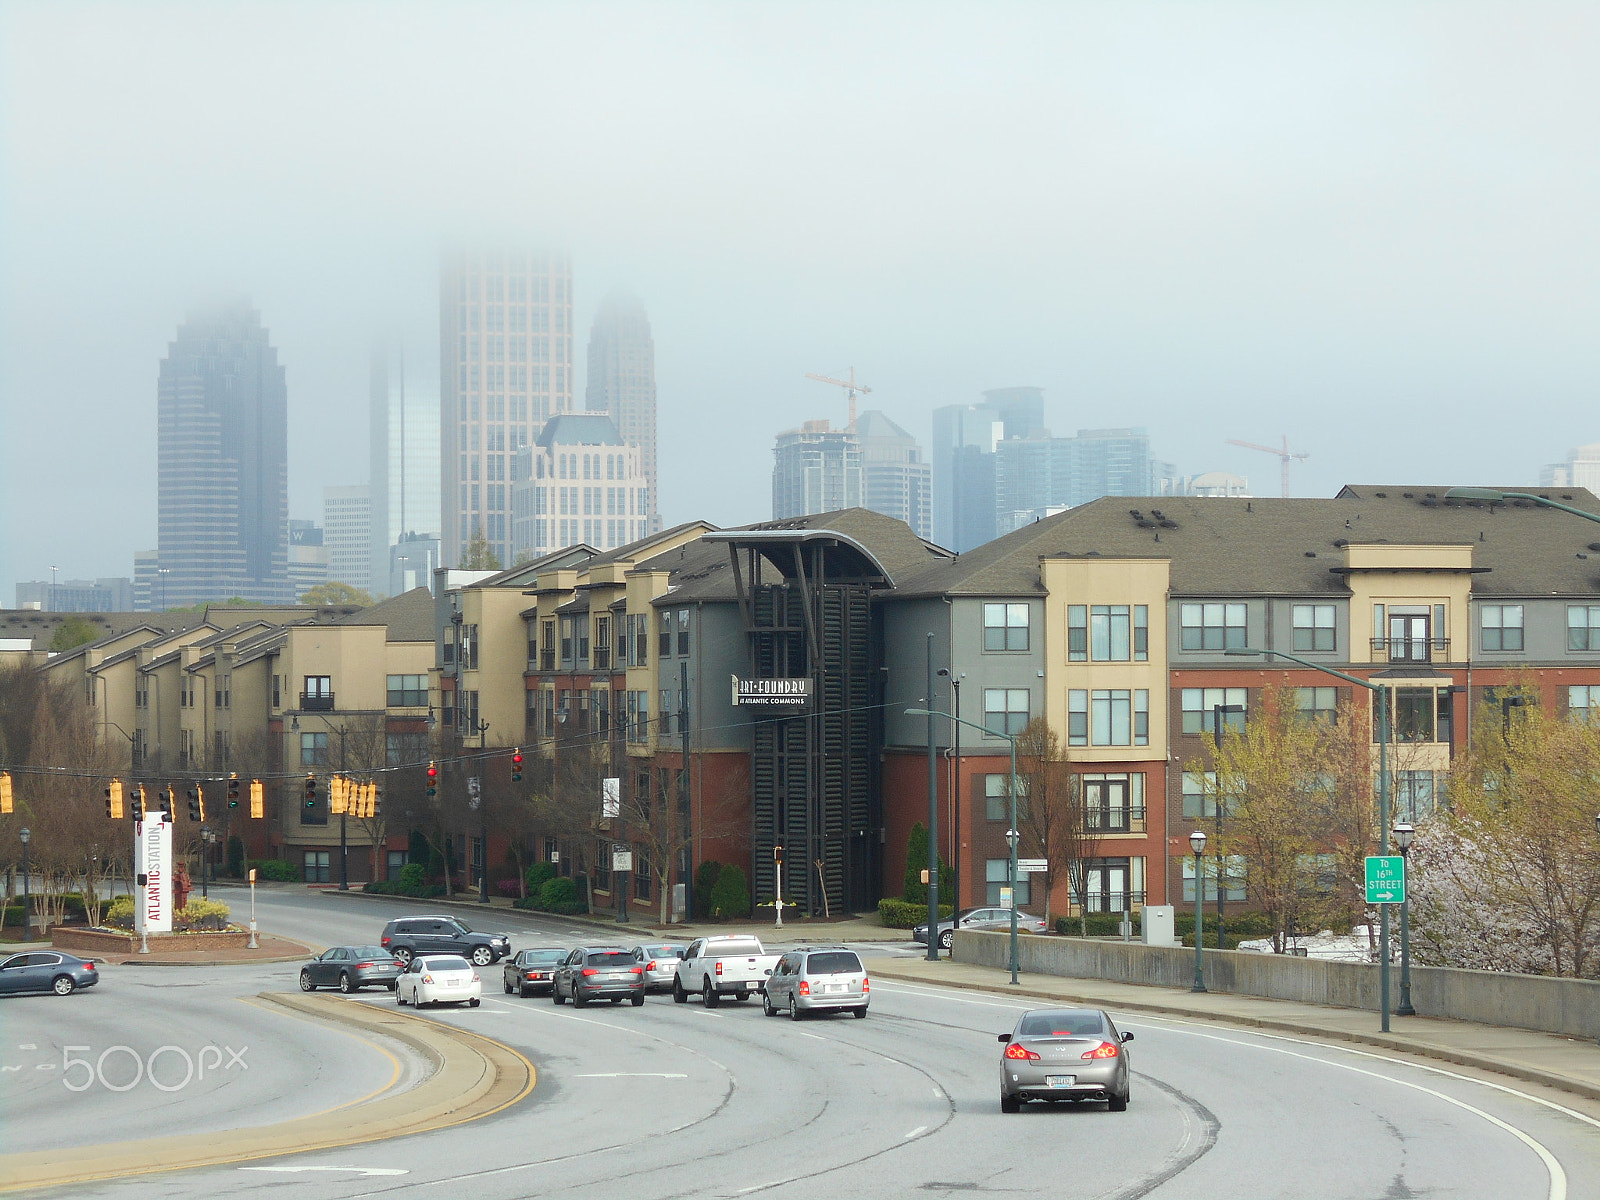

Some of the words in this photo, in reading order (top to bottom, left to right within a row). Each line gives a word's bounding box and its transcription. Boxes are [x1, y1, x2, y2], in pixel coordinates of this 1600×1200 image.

[1380, 859, 1389, 868] TO
[1376, 869, 1393, 879] 16TH
[1369, 880, 1402, 890] STREET
